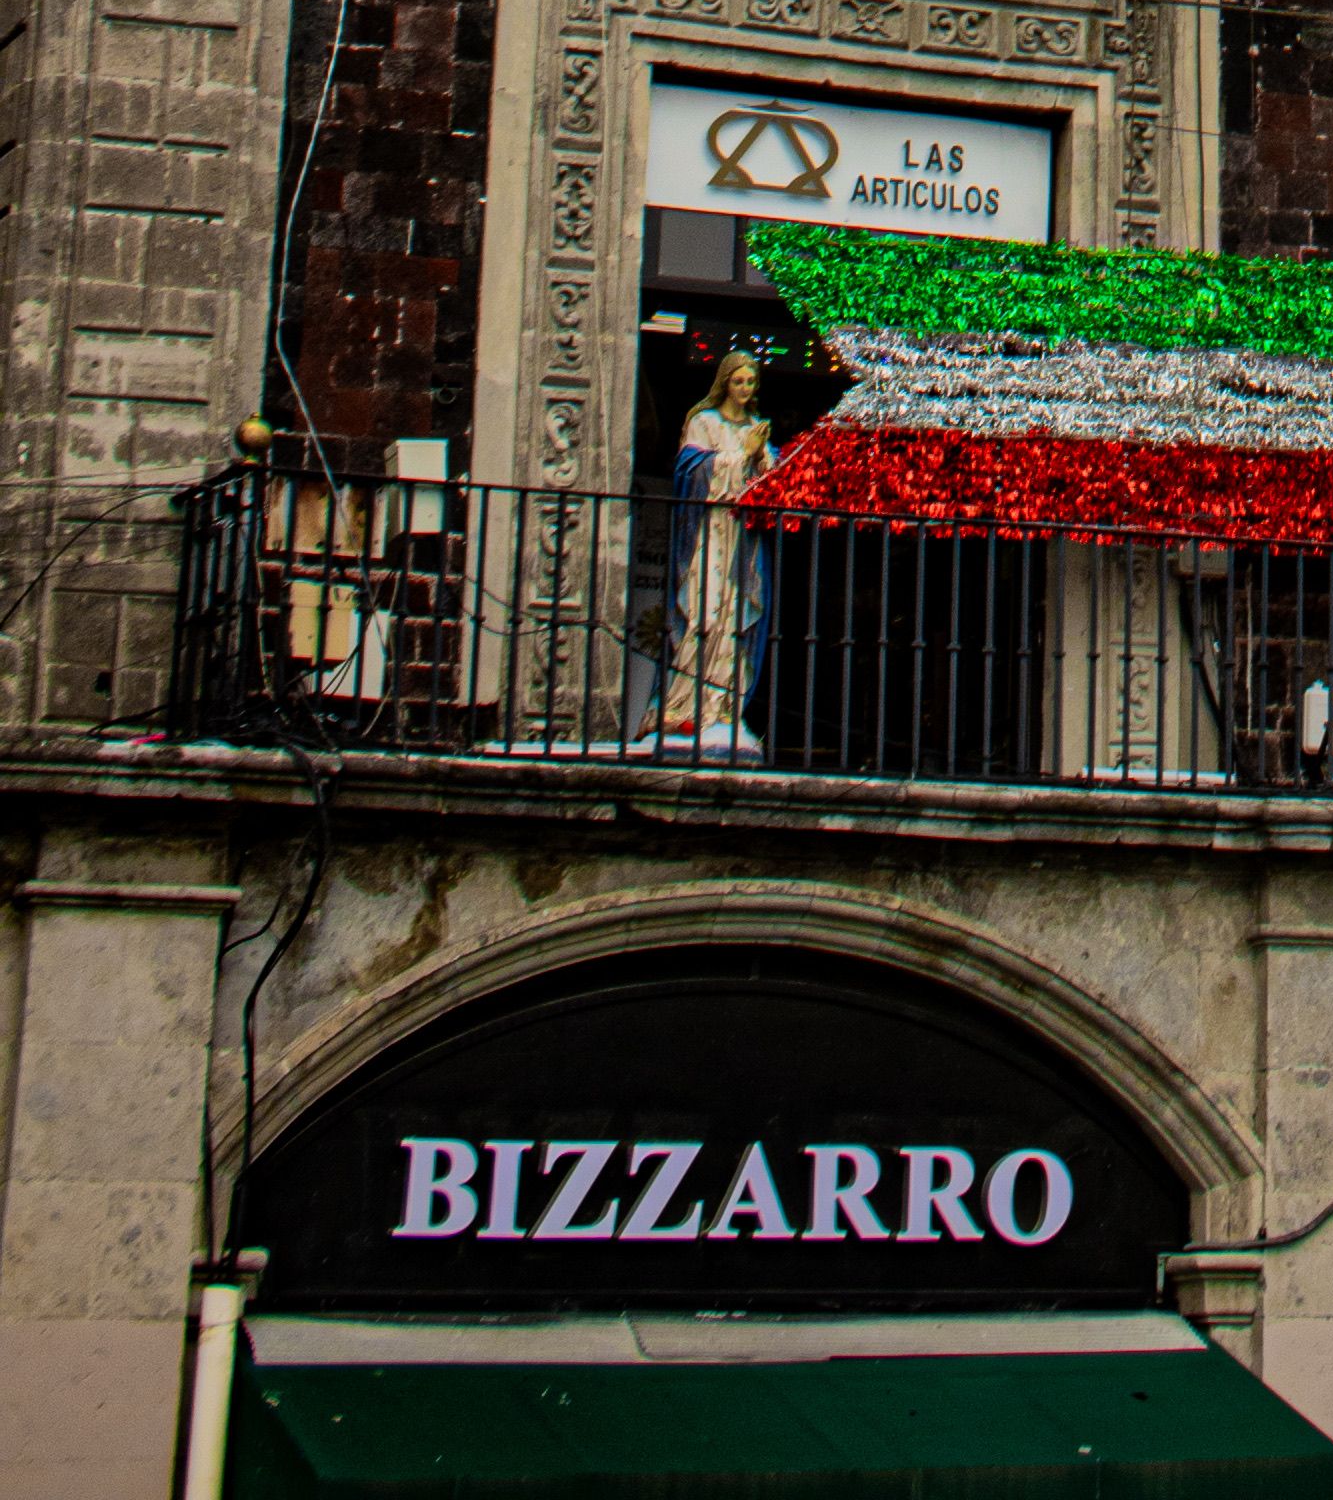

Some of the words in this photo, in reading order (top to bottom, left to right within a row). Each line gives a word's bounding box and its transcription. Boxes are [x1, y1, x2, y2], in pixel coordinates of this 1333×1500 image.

[904, 139, 965, 174] LAS
[851, 175, 1000, 217] ARTICULOS
[390, 1136, 1075, 1246] BIZZARRO
